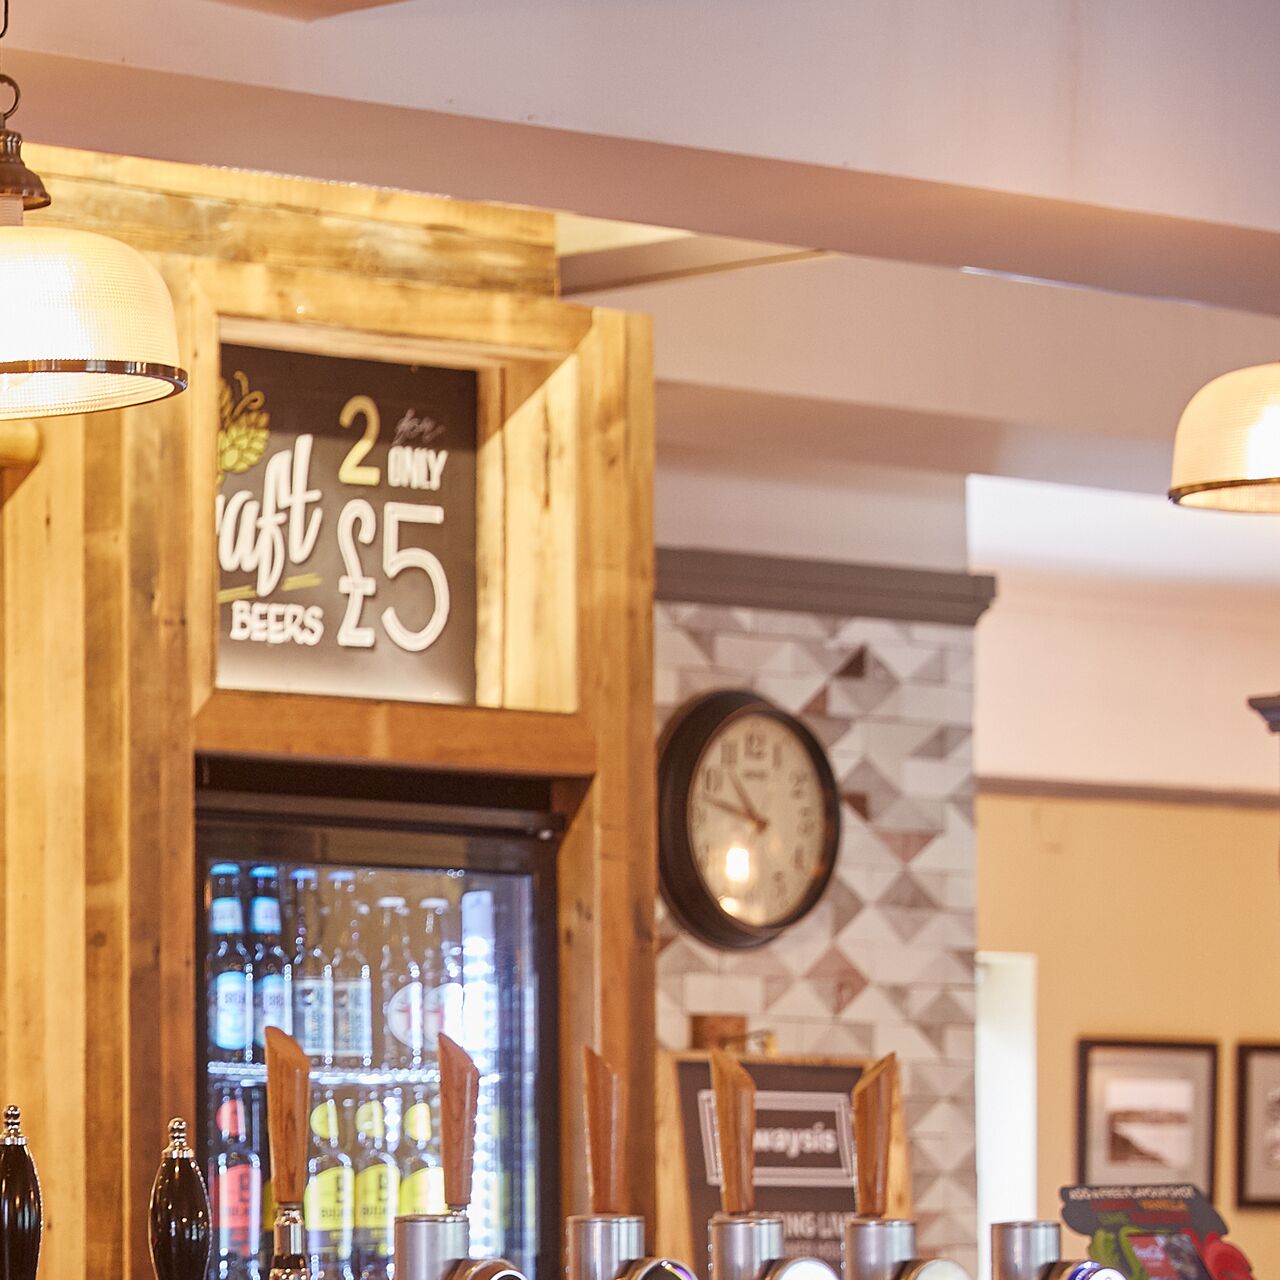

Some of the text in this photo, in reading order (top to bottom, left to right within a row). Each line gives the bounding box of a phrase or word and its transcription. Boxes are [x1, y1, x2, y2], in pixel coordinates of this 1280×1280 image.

[339, 394, 381, 486] 2
[388, 446, 449, 492] ONLY
[337, 498, 450, 652] £5
[230, 599, 324, 647] BEERS
